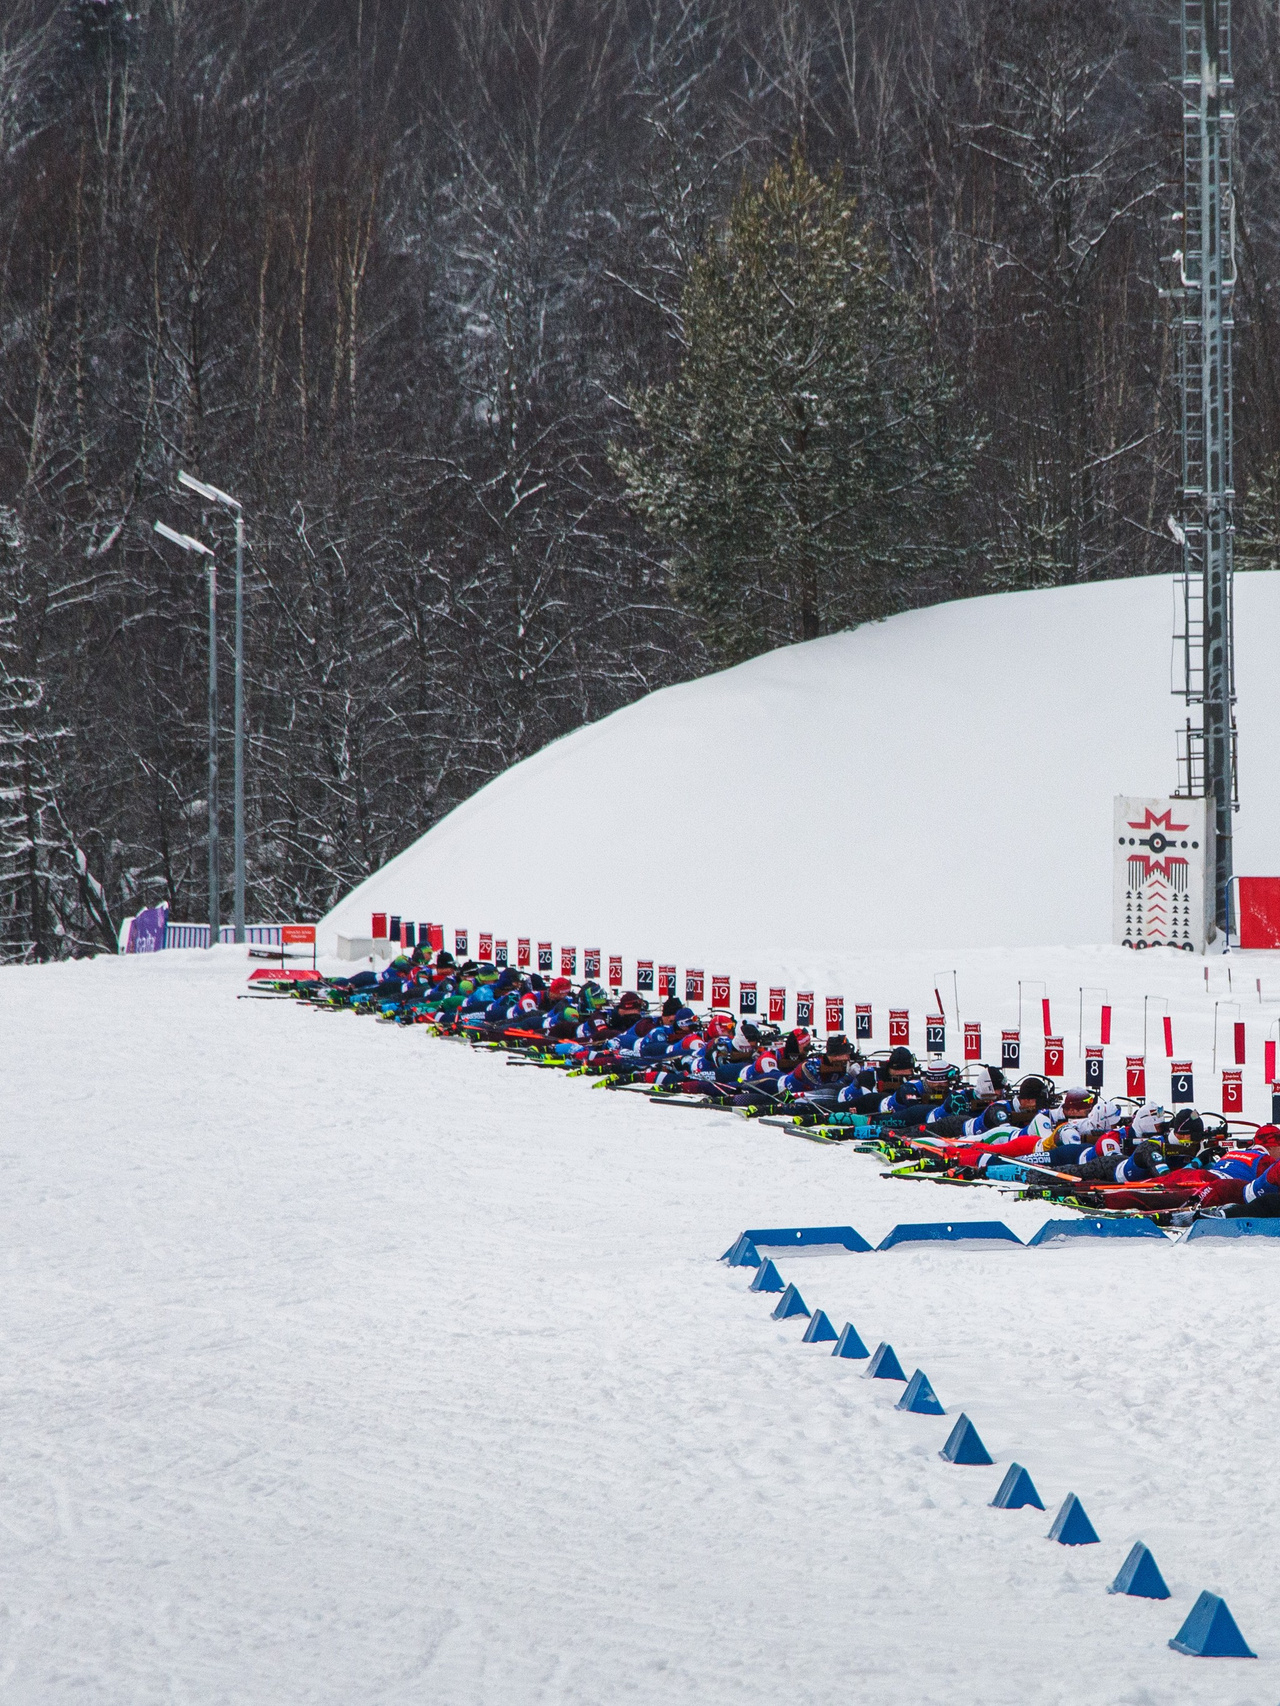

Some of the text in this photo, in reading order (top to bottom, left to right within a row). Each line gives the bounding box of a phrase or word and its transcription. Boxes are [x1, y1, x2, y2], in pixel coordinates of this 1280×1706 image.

[456, 939, 466, 949] 30
[480, 942, 492, 953] 29
[496, 950, 507, 961] 28
[519, 948, 529, 959] 27
[540, 952, 552, 963] 26
[561, 957, 570, 969] 25
[586, 959, 594, 971] 24
[609, 966, 621, 978] 23
[638, 971, 652, 983] 22
[659, 975, 667, 987] 21
[714, 987, 728, 999] 19
[741, 993, 755, 1005] 18
[770, 999, 781, 1012] 17
[798, 1004, 808, 1017] 16
[827, 1009, 837, 1022] 15
[857, 1016, 869, 1030] 14
[891, 1022, 907, 1036] 13
[929, 1028, 942, 1042] 12
[966, 1035, 976, 1050] 11
[1003, 1044, 1018, 1058] 10
[1049, 1051, 1058, 1065] 9
[1090, 1061, 1099, 1076] 8
[1132, 1070, 1139, 1086] 7
[1178, 1076, 1187, 1092] 6
[1228, 1085, 1237, 1101] 5
